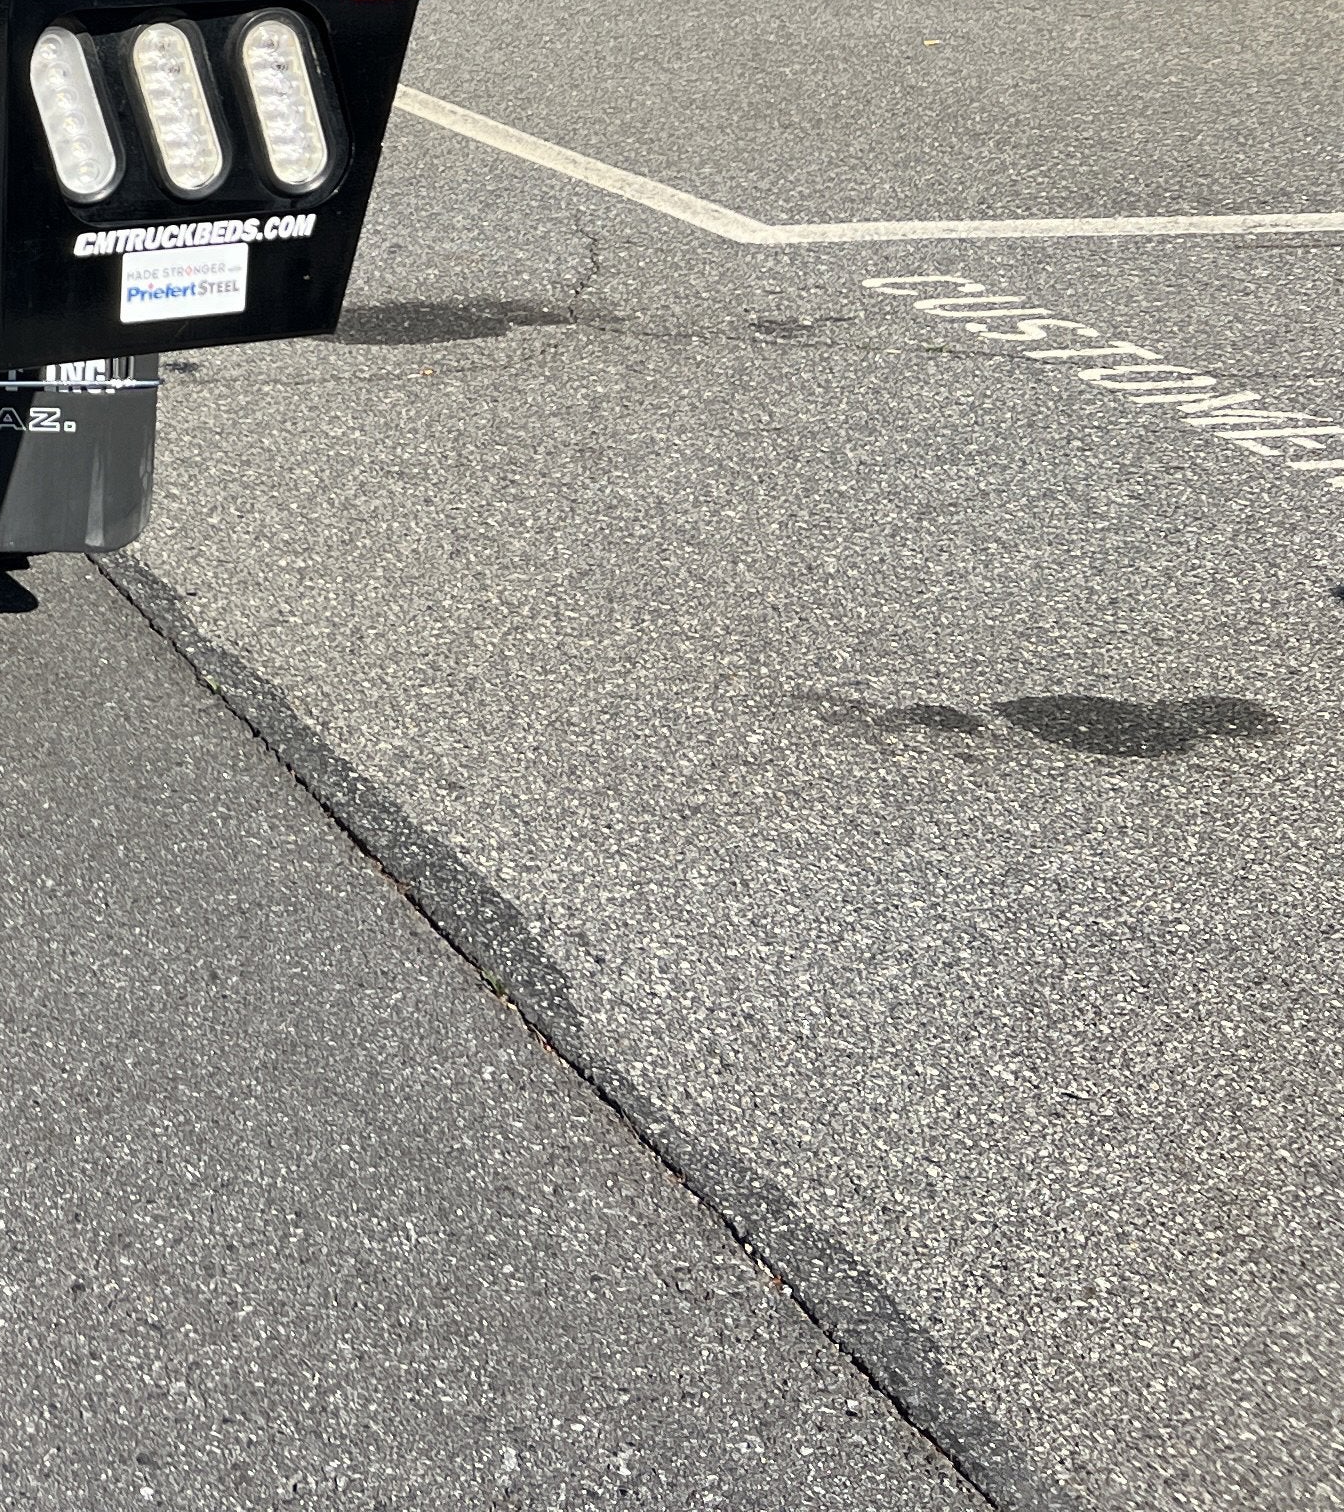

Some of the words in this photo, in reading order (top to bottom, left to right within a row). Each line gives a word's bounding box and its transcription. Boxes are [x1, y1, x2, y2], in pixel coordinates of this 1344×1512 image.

[74, 214, 316, 257] CMTRUCKBEDS.COM
[127, 282, 196, 302] Priefert
[197, 280, 240, 296] STEEL
